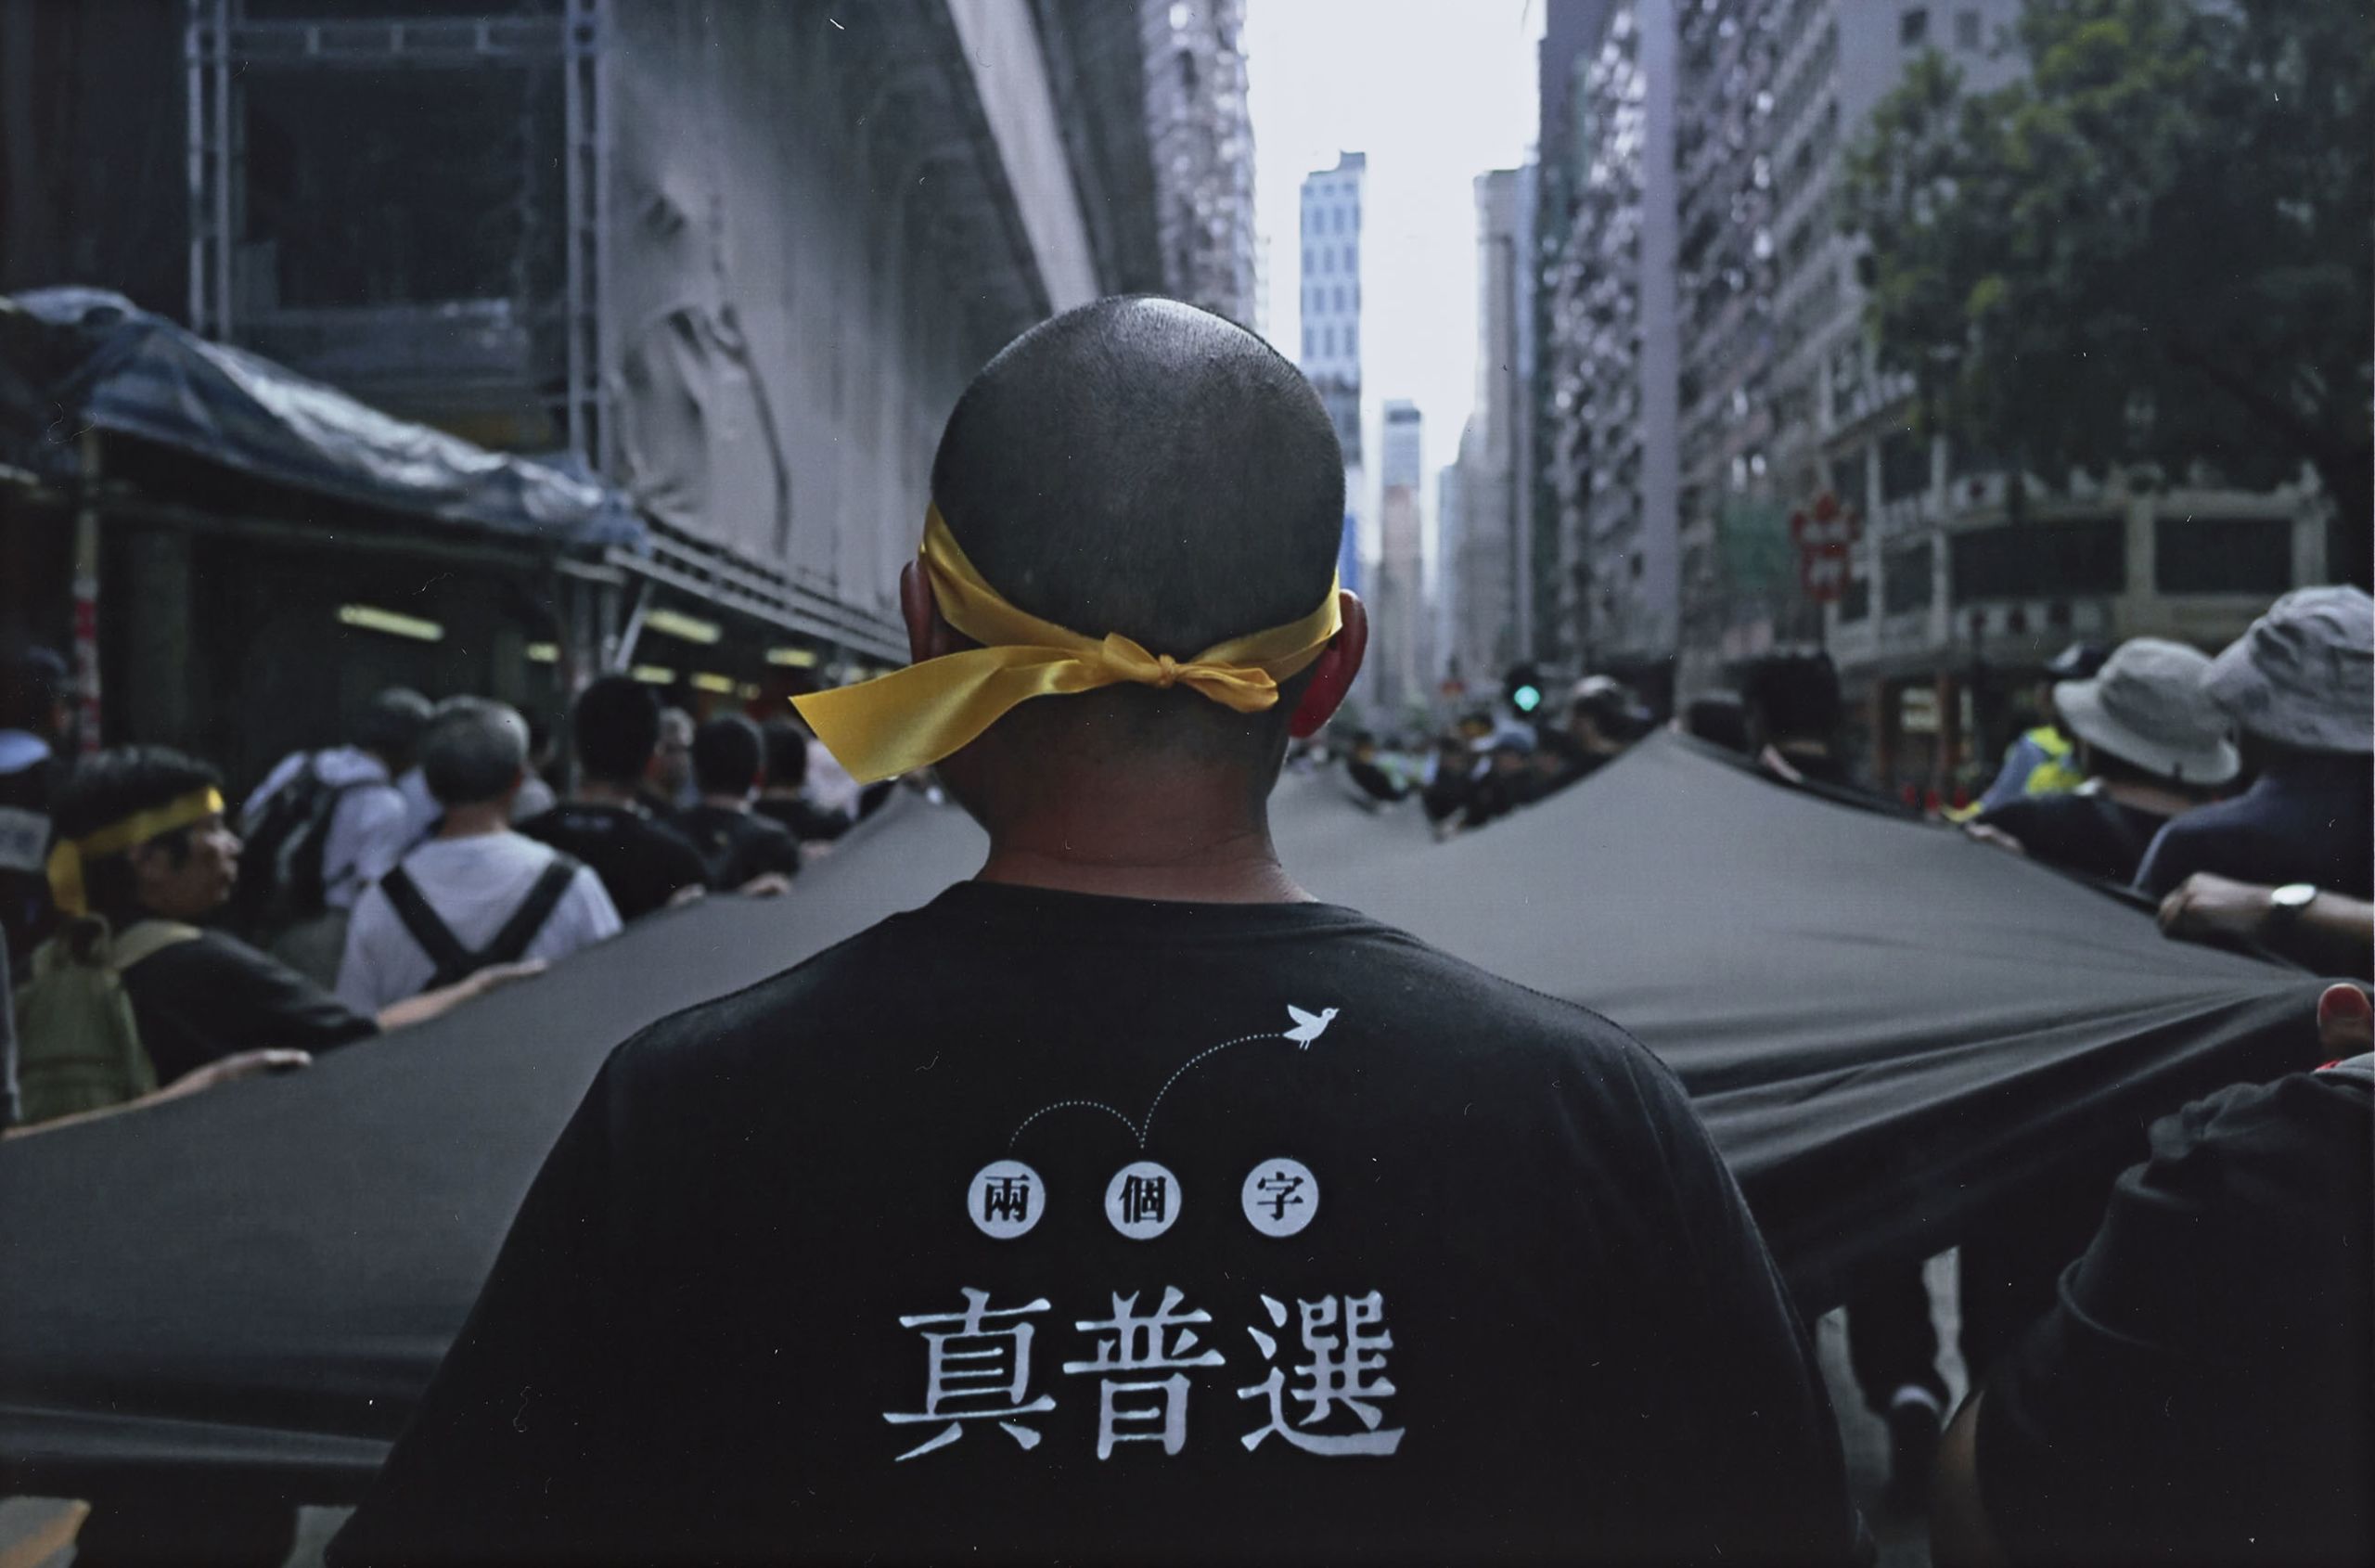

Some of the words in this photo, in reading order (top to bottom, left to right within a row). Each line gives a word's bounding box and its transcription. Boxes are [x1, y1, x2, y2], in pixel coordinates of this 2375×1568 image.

[983, 1172, 1303, 1224] 兩個字
[882, 1286, 1406, 1461] 真普選
